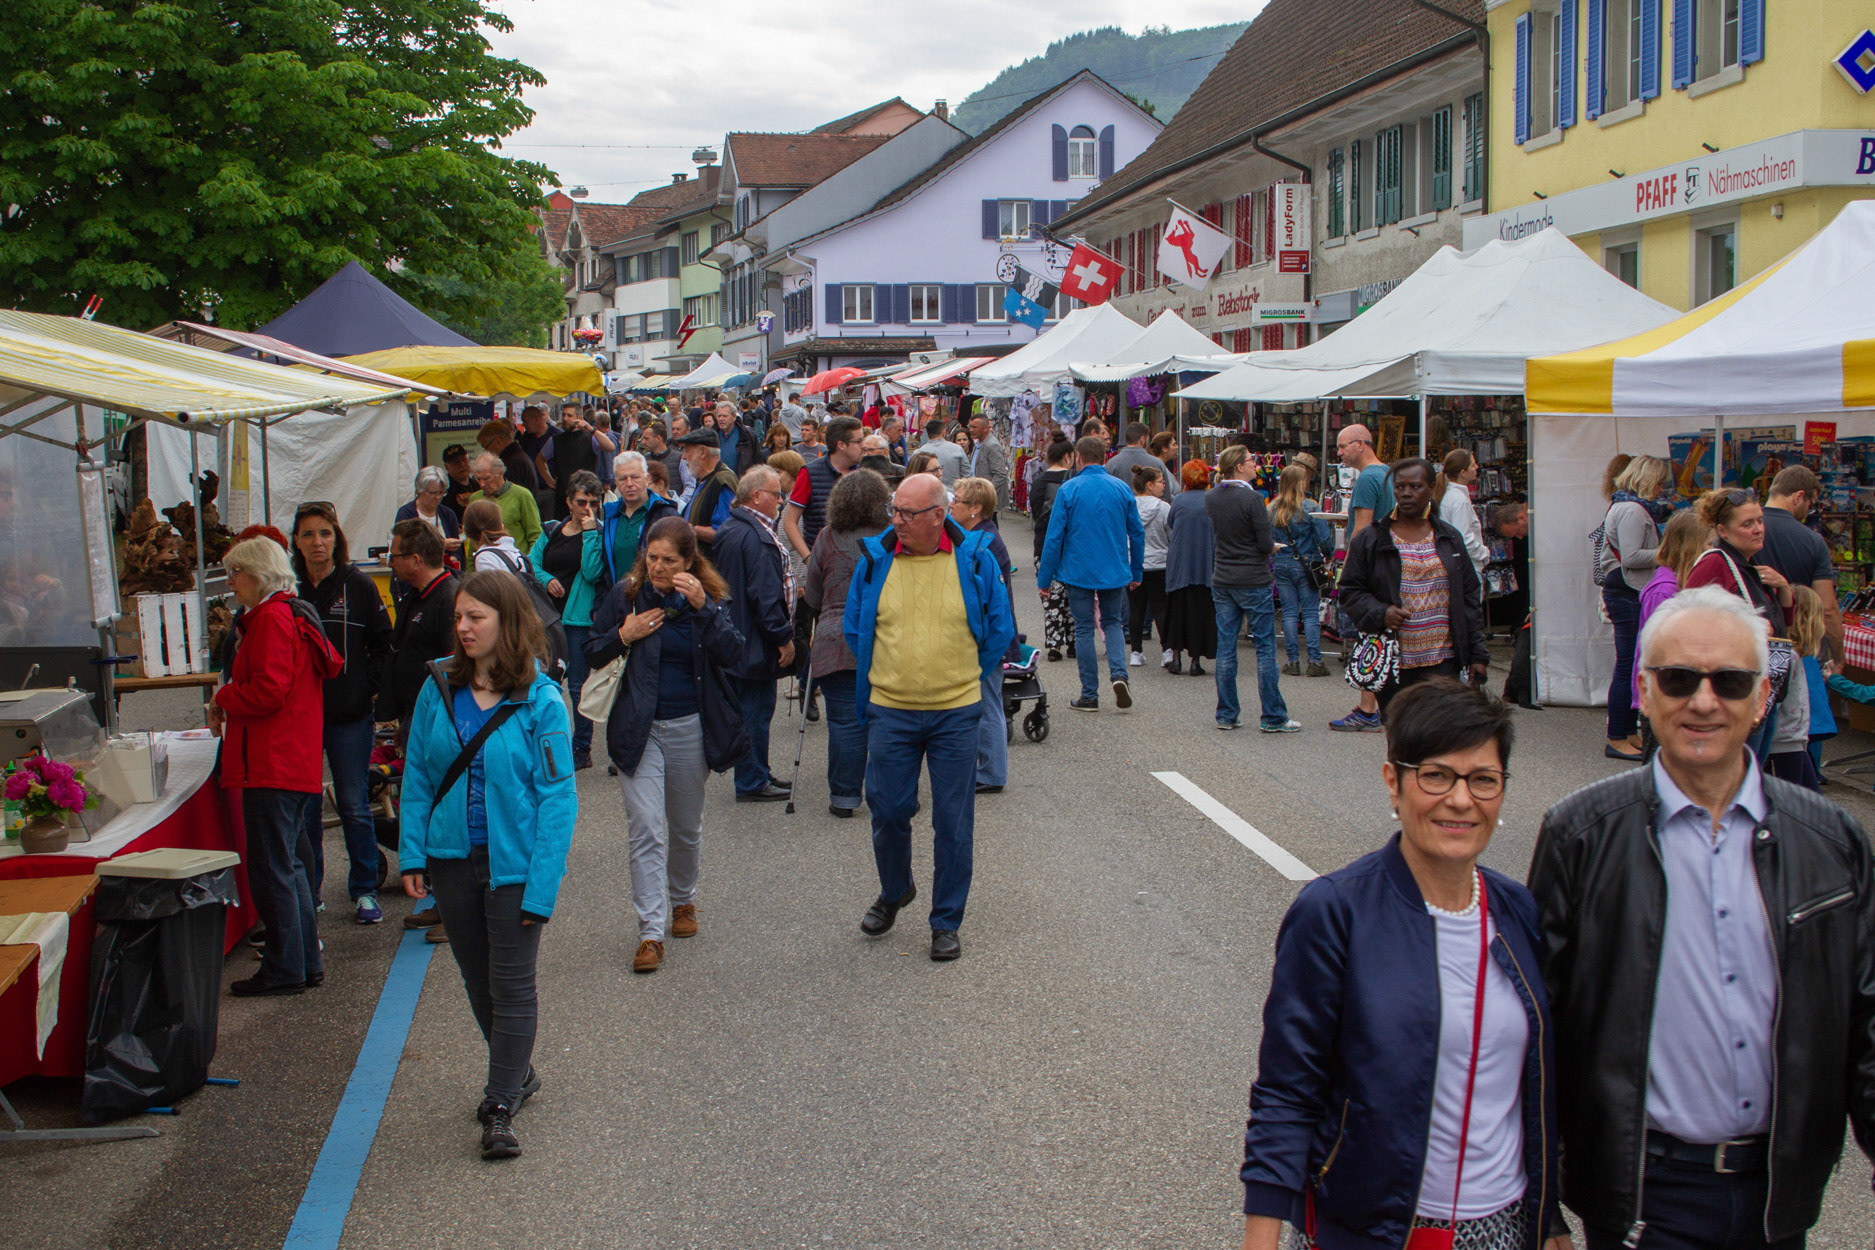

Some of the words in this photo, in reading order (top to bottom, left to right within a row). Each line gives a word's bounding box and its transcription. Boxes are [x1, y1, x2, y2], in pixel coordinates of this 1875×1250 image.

[1636, 173, 1677, 213] PFAFF
[1708, 154, 1796, 197] Nähmaschinen
[1284, 188, 1296, 248] LadyForm
[1499, 204, 1554, 241] Kindermode
[1191, 305, 1207, 318] zum
[1217, 286, 1260, 317] Rebstock
[451, 407, 472, 416] Multi
